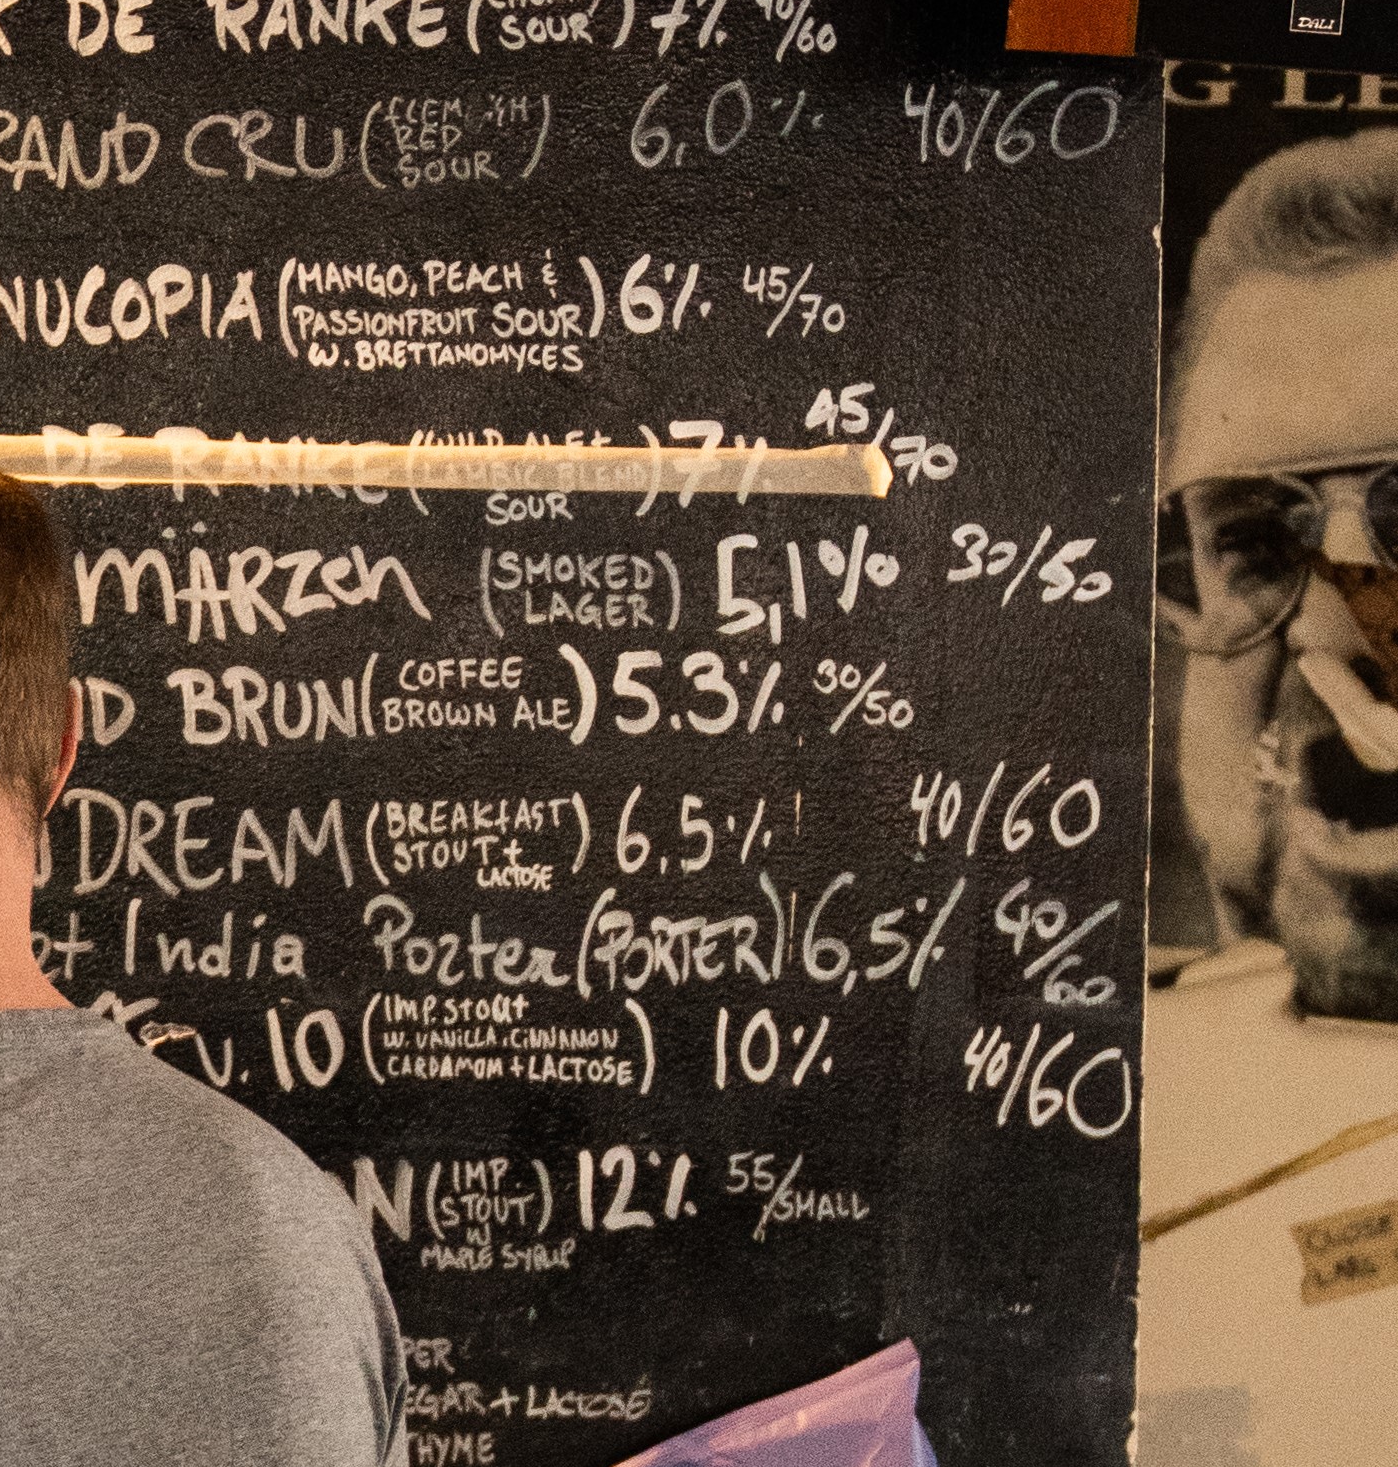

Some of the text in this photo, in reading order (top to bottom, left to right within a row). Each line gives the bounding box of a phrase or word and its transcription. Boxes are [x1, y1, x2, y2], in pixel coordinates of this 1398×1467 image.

[499, 14, 592, 49] SOUR
[184, 110, 345, 180] CRU
[424, 260, 523, 295] PEACH
[293, 303, 583, 338] PASSIONFRUIT SOUR
[486, 491, 573, 526] SOUR
[492, 551, 656, 590] SMOKED
[523, 594, 656, 629] LAGER
[167, 667, 357, 746] BRUN
[400, 657, 524, 690] COFFEE
[381, 695, 574, 730] BROWN ALE
[62, 787, 354, 897] DREAM
[124, 898, 305, 980] India
